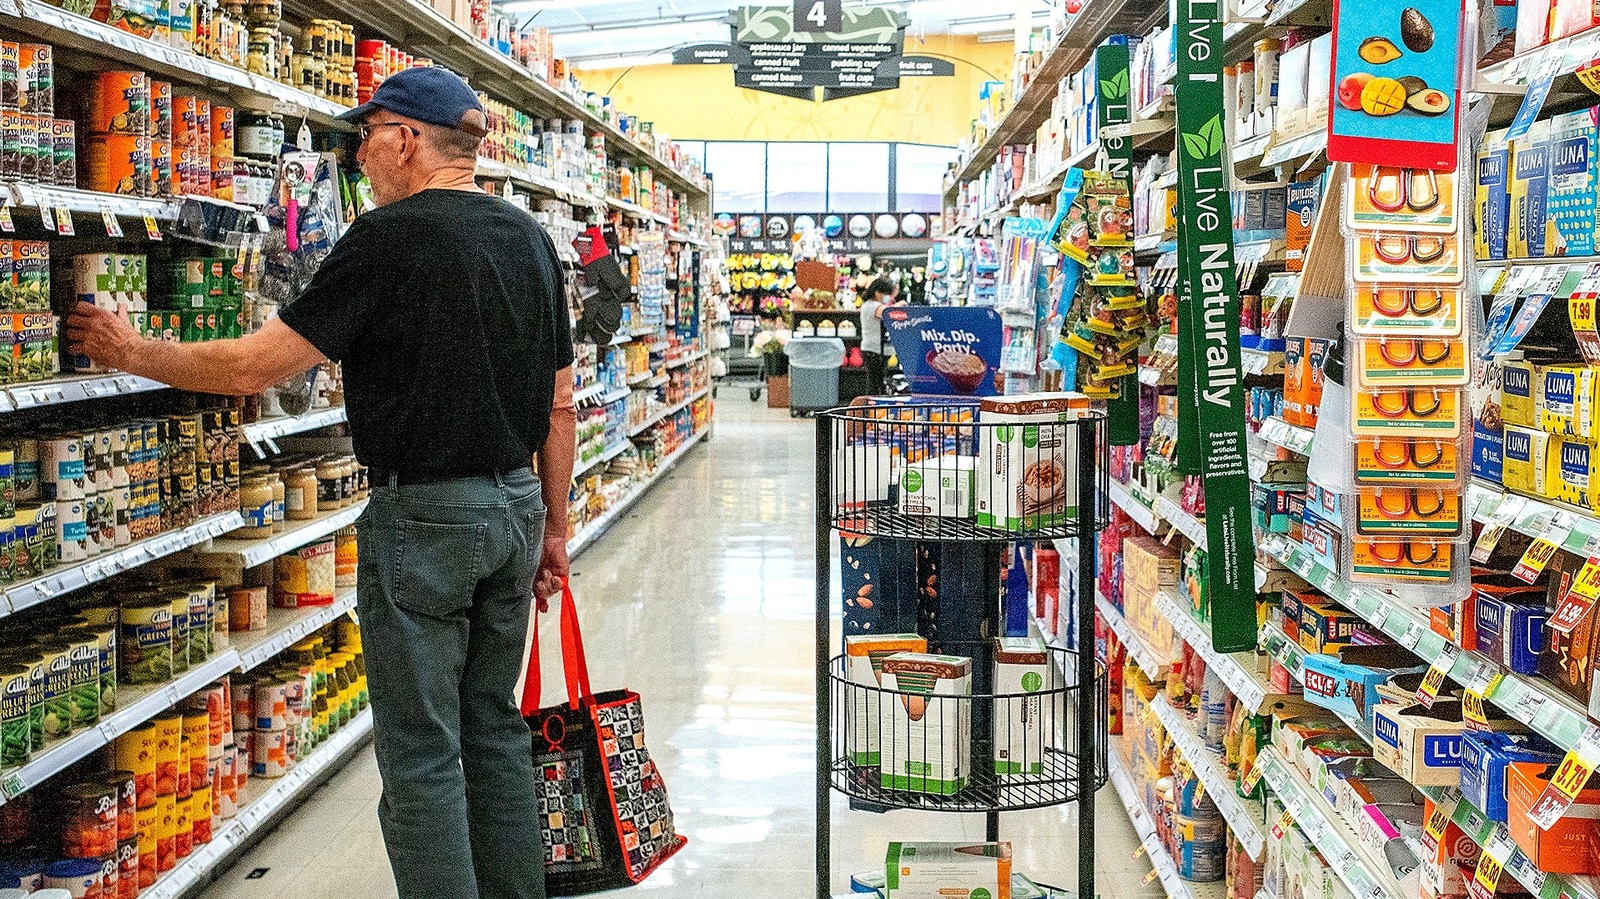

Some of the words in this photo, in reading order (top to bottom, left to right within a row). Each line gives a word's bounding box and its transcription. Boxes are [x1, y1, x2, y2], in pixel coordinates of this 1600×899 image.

[806, 0, 827, 26] 4
[694, 50, 728, 58] tomatoes
[750, 43, 791, 52] applesauce
[792, 42, 807, 53] jars
[822, 44, 850, 52] canned
[850, 44, 892, 54] vegetables
[754, 58, 782, 66] canned
[783, 58, 800, 66] fruit
[830, 59, 863, 68] pudding
[916, 62, 933, 70] cups
[751, 73, 780, 81] canned
[780, 73, 803, 82] beans
[838, 73, 856, 82] fruit
[1106, 104, 1128, 150] Lie
[1519, 153, 1543, 172] LUNA
[1554, 144, 1585, 166] LUNA
[1480, 160, 1500, 178] LUNA
[1193, 166, 1223, 232] Live
[1572, 302, 1590, 320] 7.99
[1199, 243, 1237, 408] Naturally
[920, 329, 950, 342] Mix.
[950, 329, 980, 344] Dip.
[934, 342, 976, 355] Party.
[1505, 370, 1528, 389] LUNA
[1548, 377, 1572, 396] LUNA
[1508, 434, 1528, 454] LUNA
[1208, 454, 1242, 462] ingredients,
[1564, 447, 1587, 467] LUNA
[1206, 469, 1246, 478] preservatives.
[1527, 540, 1555, 564] 4/5.00
[1524, 568, 1536, 582] PRICE
[1480, 602, 1498, 625] LUNA
[1558, 602, 1584, 622] 6.99
[1377, 717, 1397, 741] LUNA
[1464, 744, 1478, 766] LUNA
[1556, 759, 1588, 794] 9.79
[1480, 855, 1500, 884] 4/5.00
